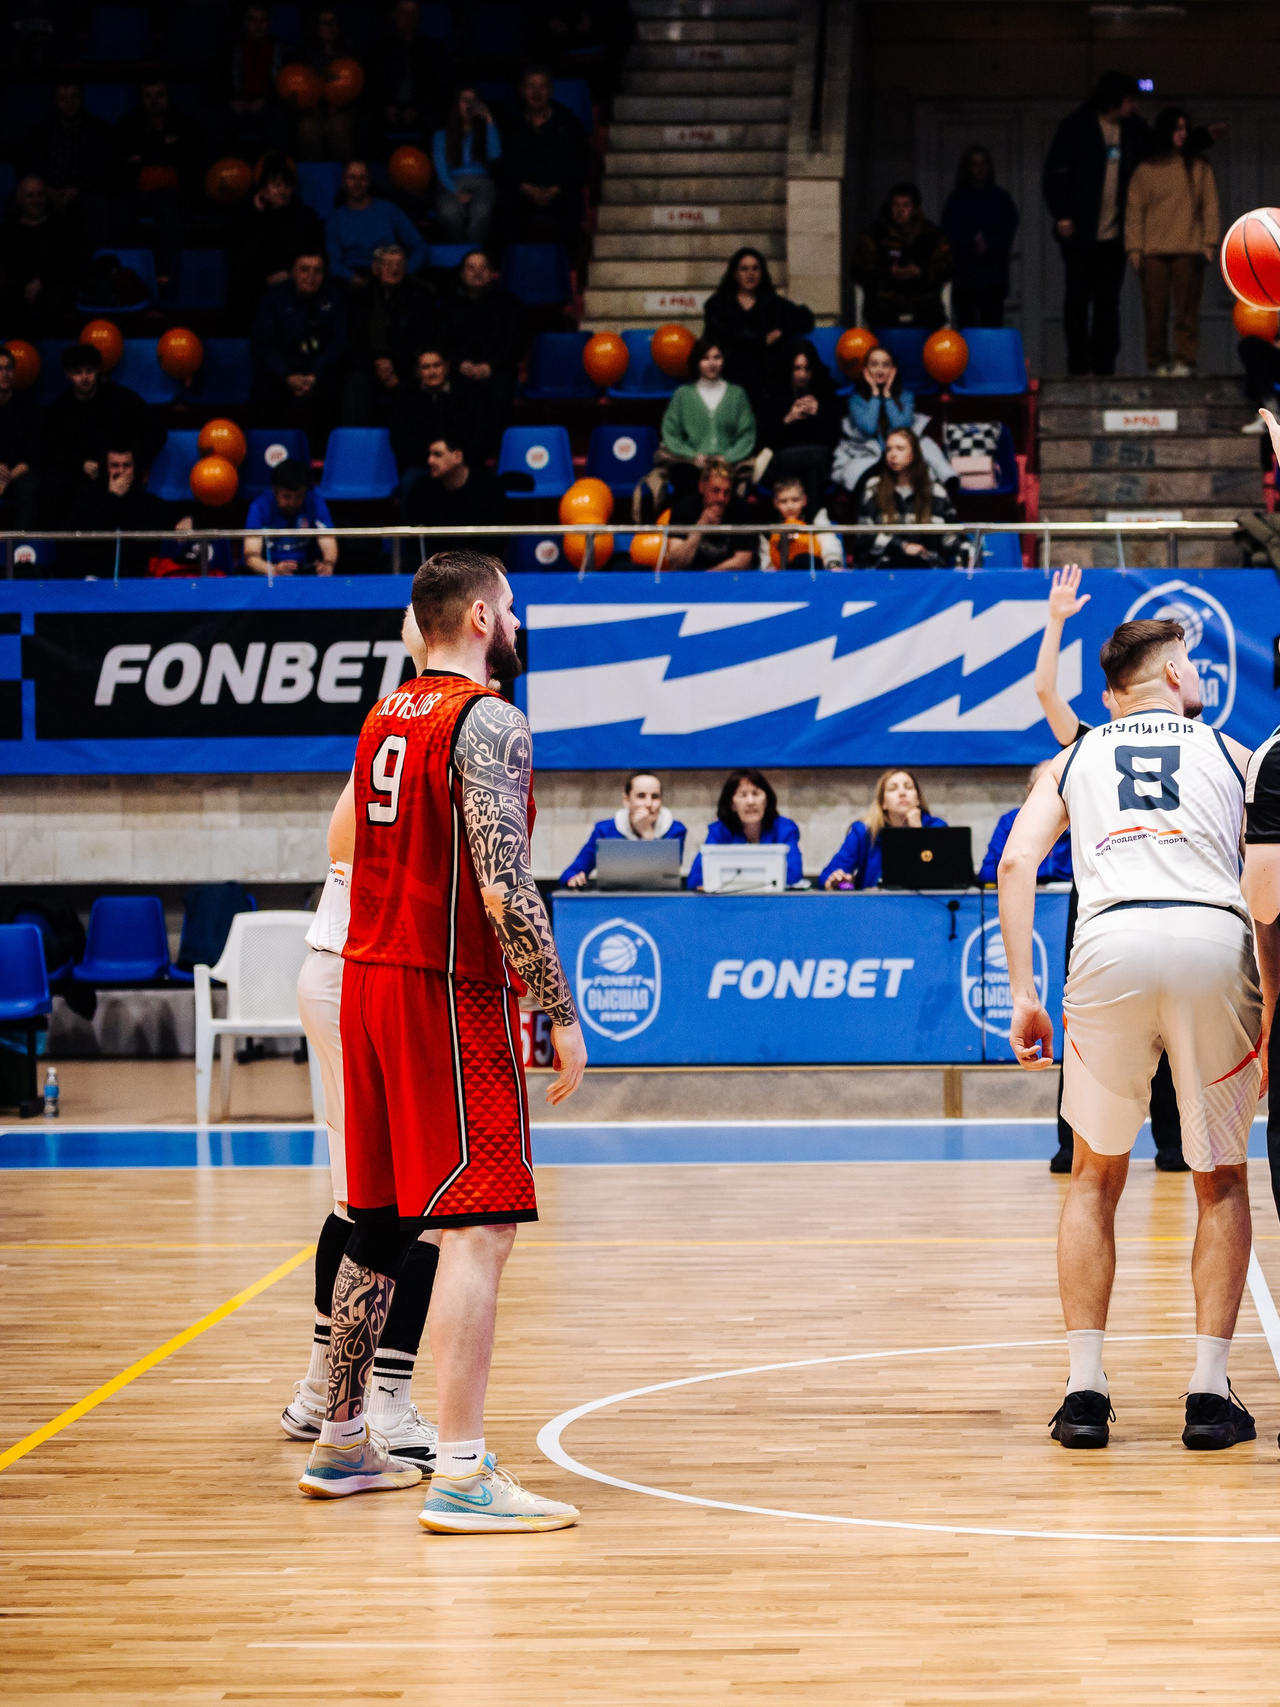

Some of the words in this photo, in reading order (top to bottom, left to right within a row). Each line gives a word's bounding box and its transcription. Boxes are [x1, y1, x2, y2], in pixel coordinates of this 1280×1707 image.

[94, 641, 413, 706] FONBET
[366, 734, 407, 826] 9
[1114, 745, 1181, 811] 8
[1158, 837, 1188, 845] СПОРТА
[593, 975, 644, 988] FONBET
[707, 958, 915, 999] FONBET
